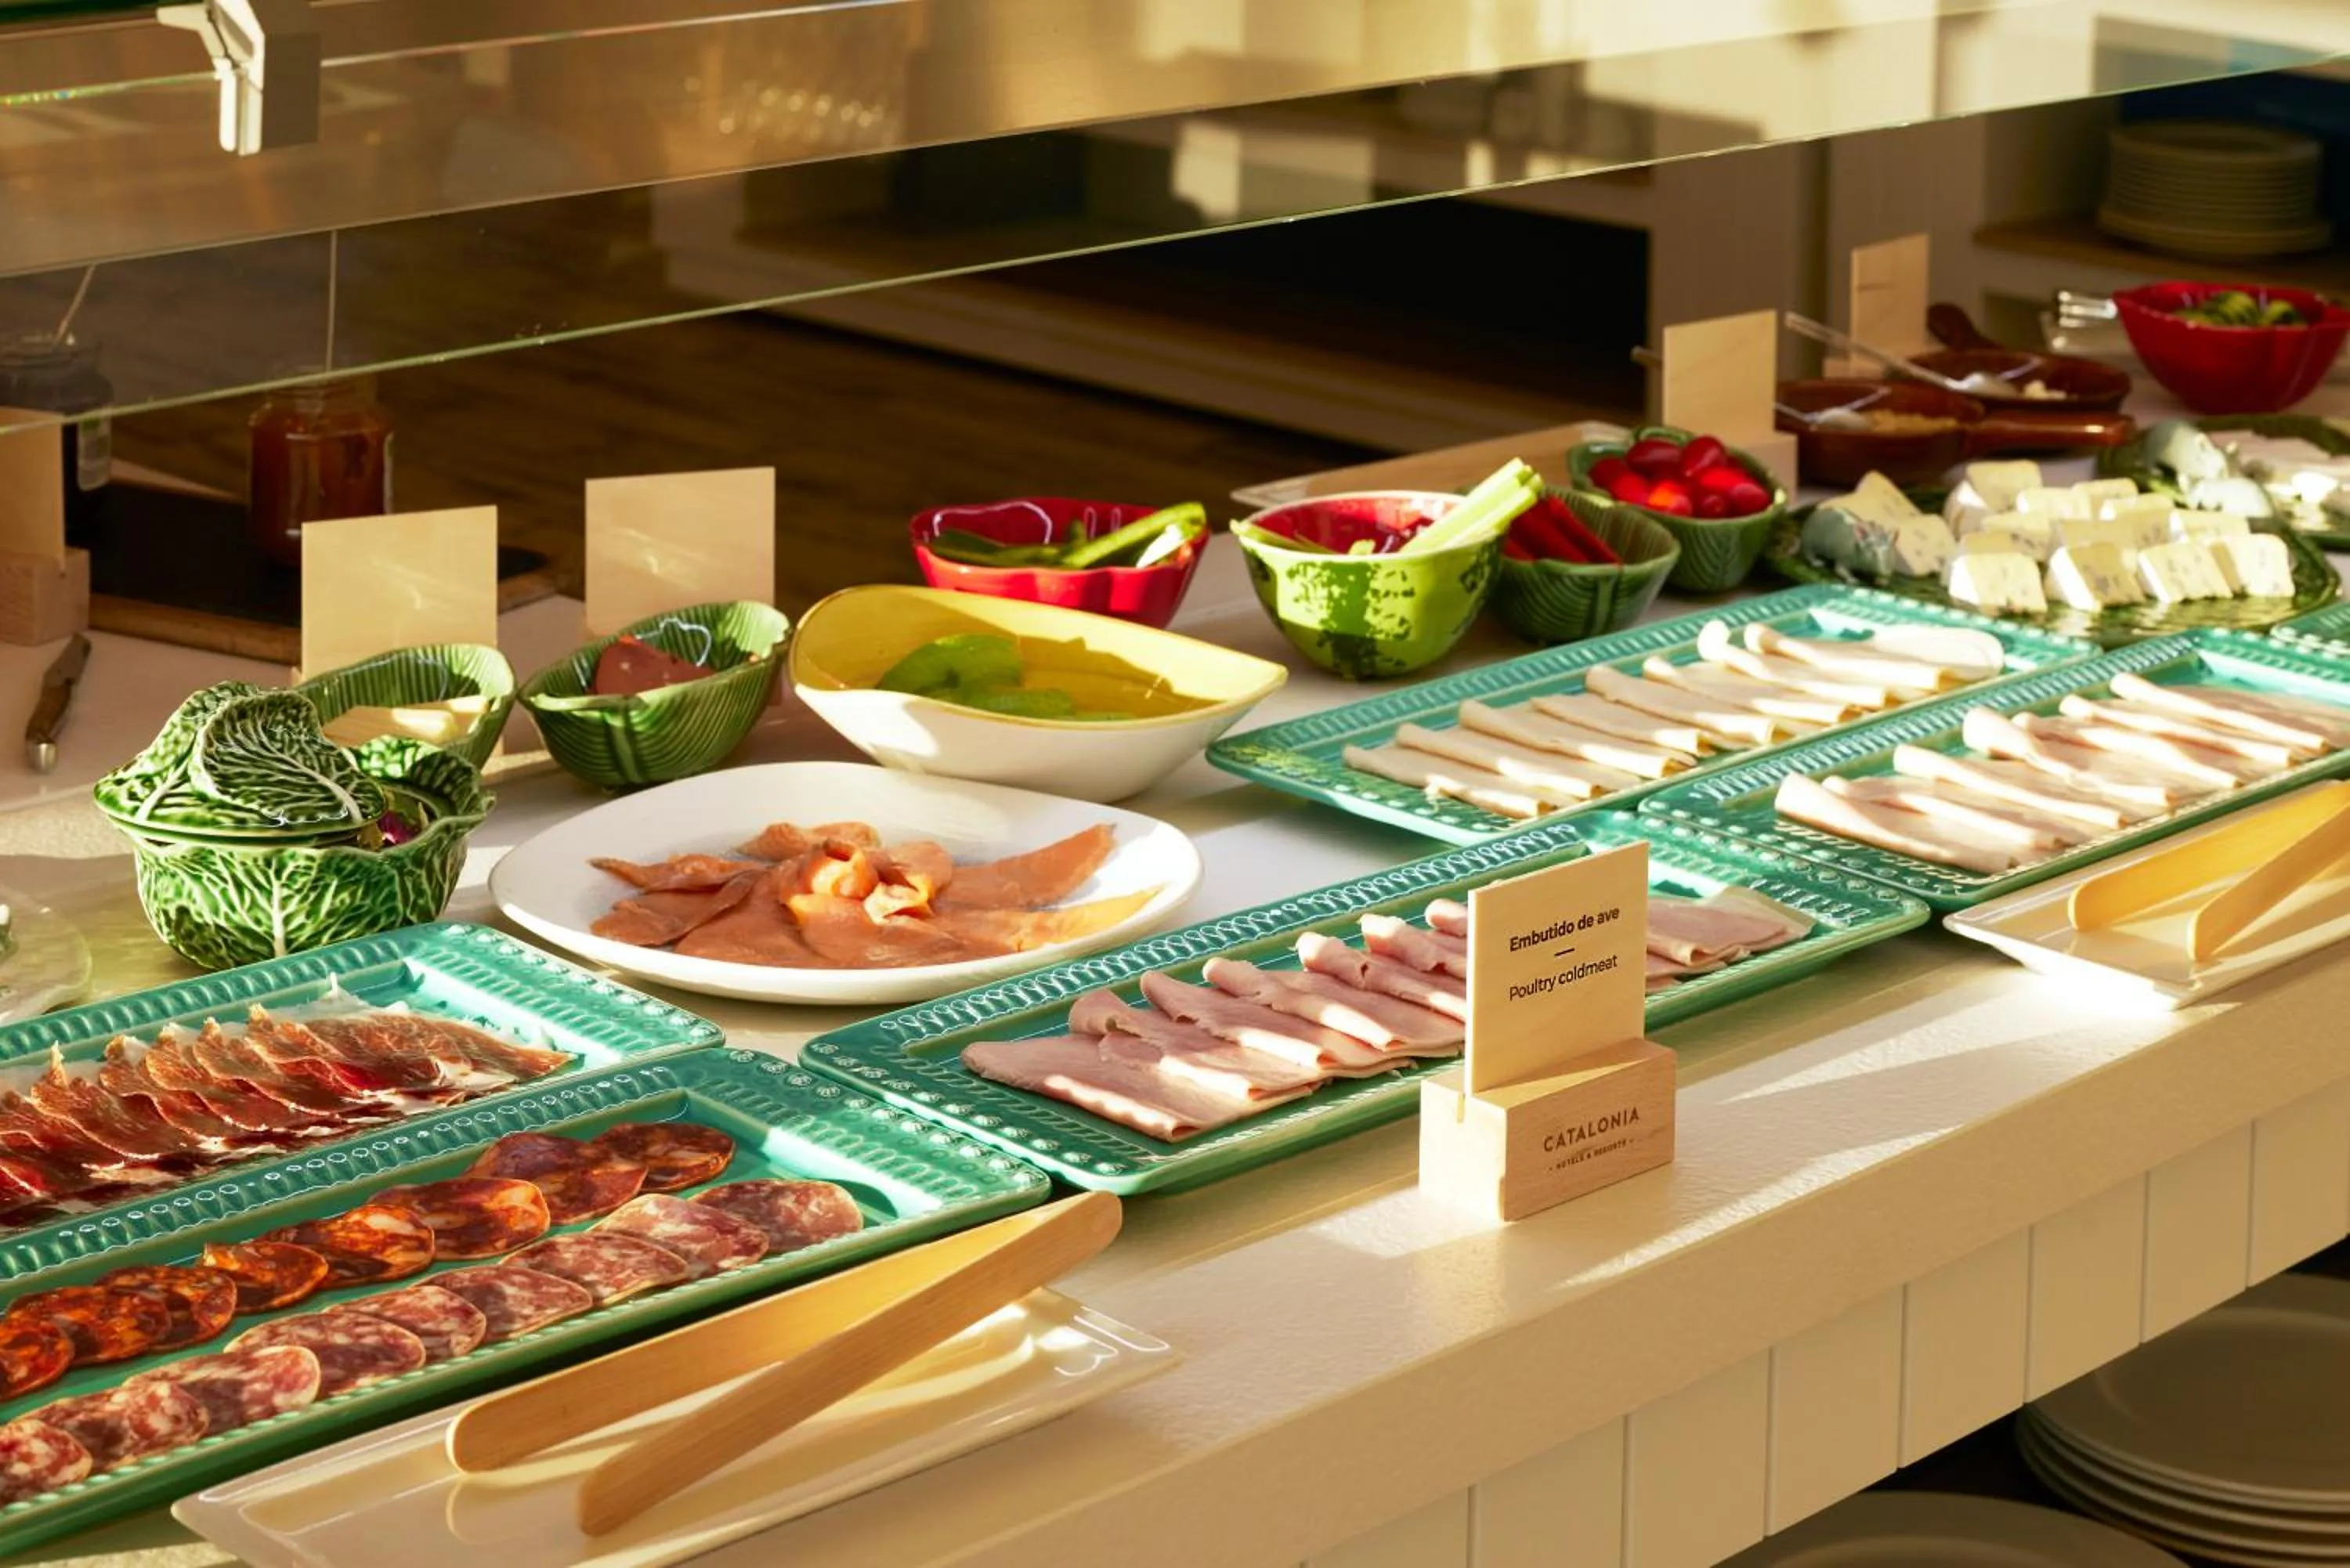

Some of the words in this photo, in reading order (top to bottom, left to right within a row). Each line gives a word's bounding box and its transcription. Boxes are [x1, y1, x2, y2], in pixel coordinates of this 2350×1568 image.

[1509, 922, 1574, 952] Embutido
[1577, 914, 1594, 930] de
[1597, 907, 1620, 924] ave
[1509, 975, 1556, 1001] Poultry
[1558, 955, 1618, 985] coldmeat
[1544, 1106, 1640, 1152] CATALONIA
